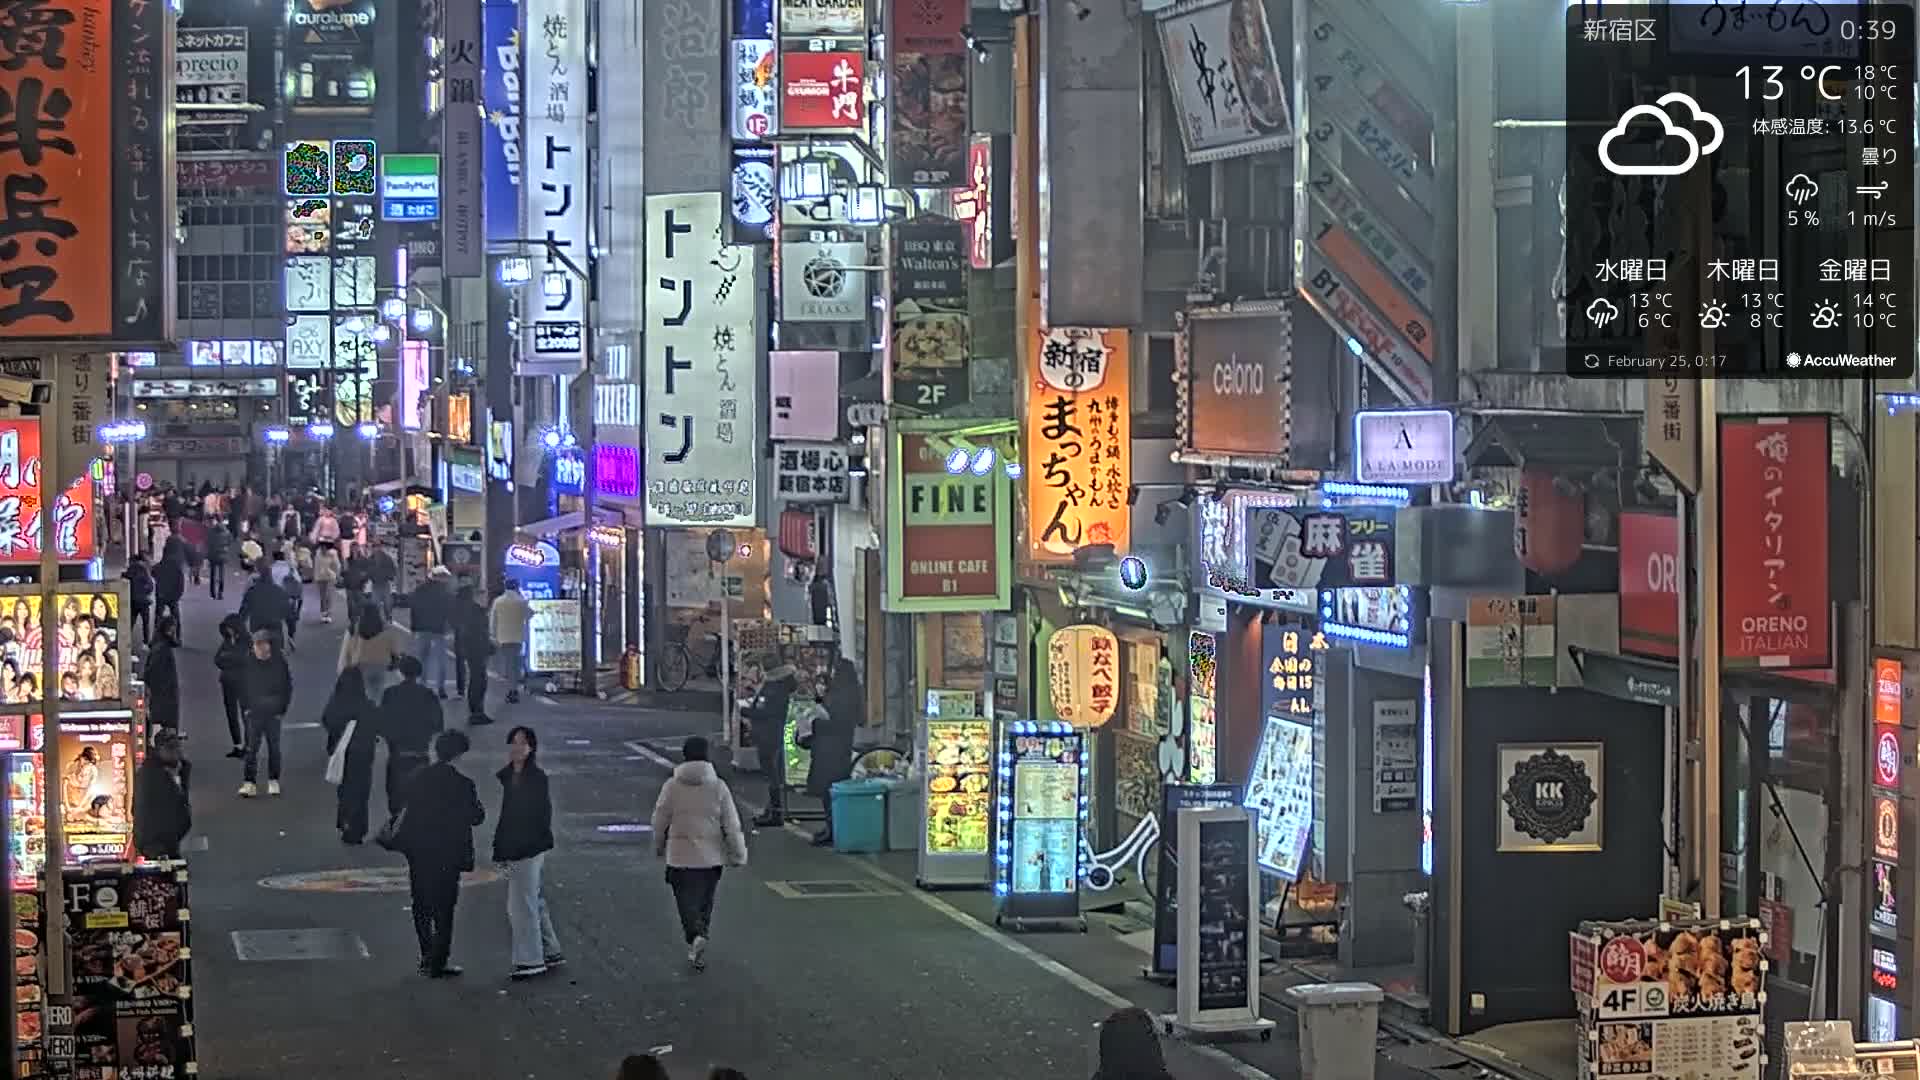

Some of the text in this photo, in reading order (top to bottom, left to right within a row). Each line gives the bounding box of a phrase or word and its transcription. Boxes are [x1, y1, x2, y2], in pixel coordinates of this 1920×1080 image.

[295, 12, 369, 25] auralume
[808, 39, 837, 52] 2F
[386, 181, 436, 193] FamilyMart
[407, 203, 435, 216] たばこ
[541, 136, 573, 311] トントン
[900, 255, 959, 272] Walton's
[1312, 268, 1340, 299] B1
[659, 209, 693, 463] トントン
[1044, 340, 1103, 375] 新宿
[1064, 373, 1084, 388] の
[1212, 352, 1264, 395] celona
[917, 385, 947, 404] 2F
[779, 450, 844, 470] 酒場心
[1041, 396, 1085, 545] まっちゃん
[779, 475, 845, 494] 新宿本店
[911, 484, 987, 513] FINE
[1756, 429, 1790, 606] 俺のイタリアン
[1349, 520, 1390, 535] フリー
[911, 560, 988, 574] ONLINE CAFE
[942, 580, 958, 593] B1
[1741, 616, 1807, 633] ORENO
[1740, 634, 1808, 651] ITALIAN
[1535, 781, 1564, 799] KK
[1602, 989, 1637, 1012] 4F
